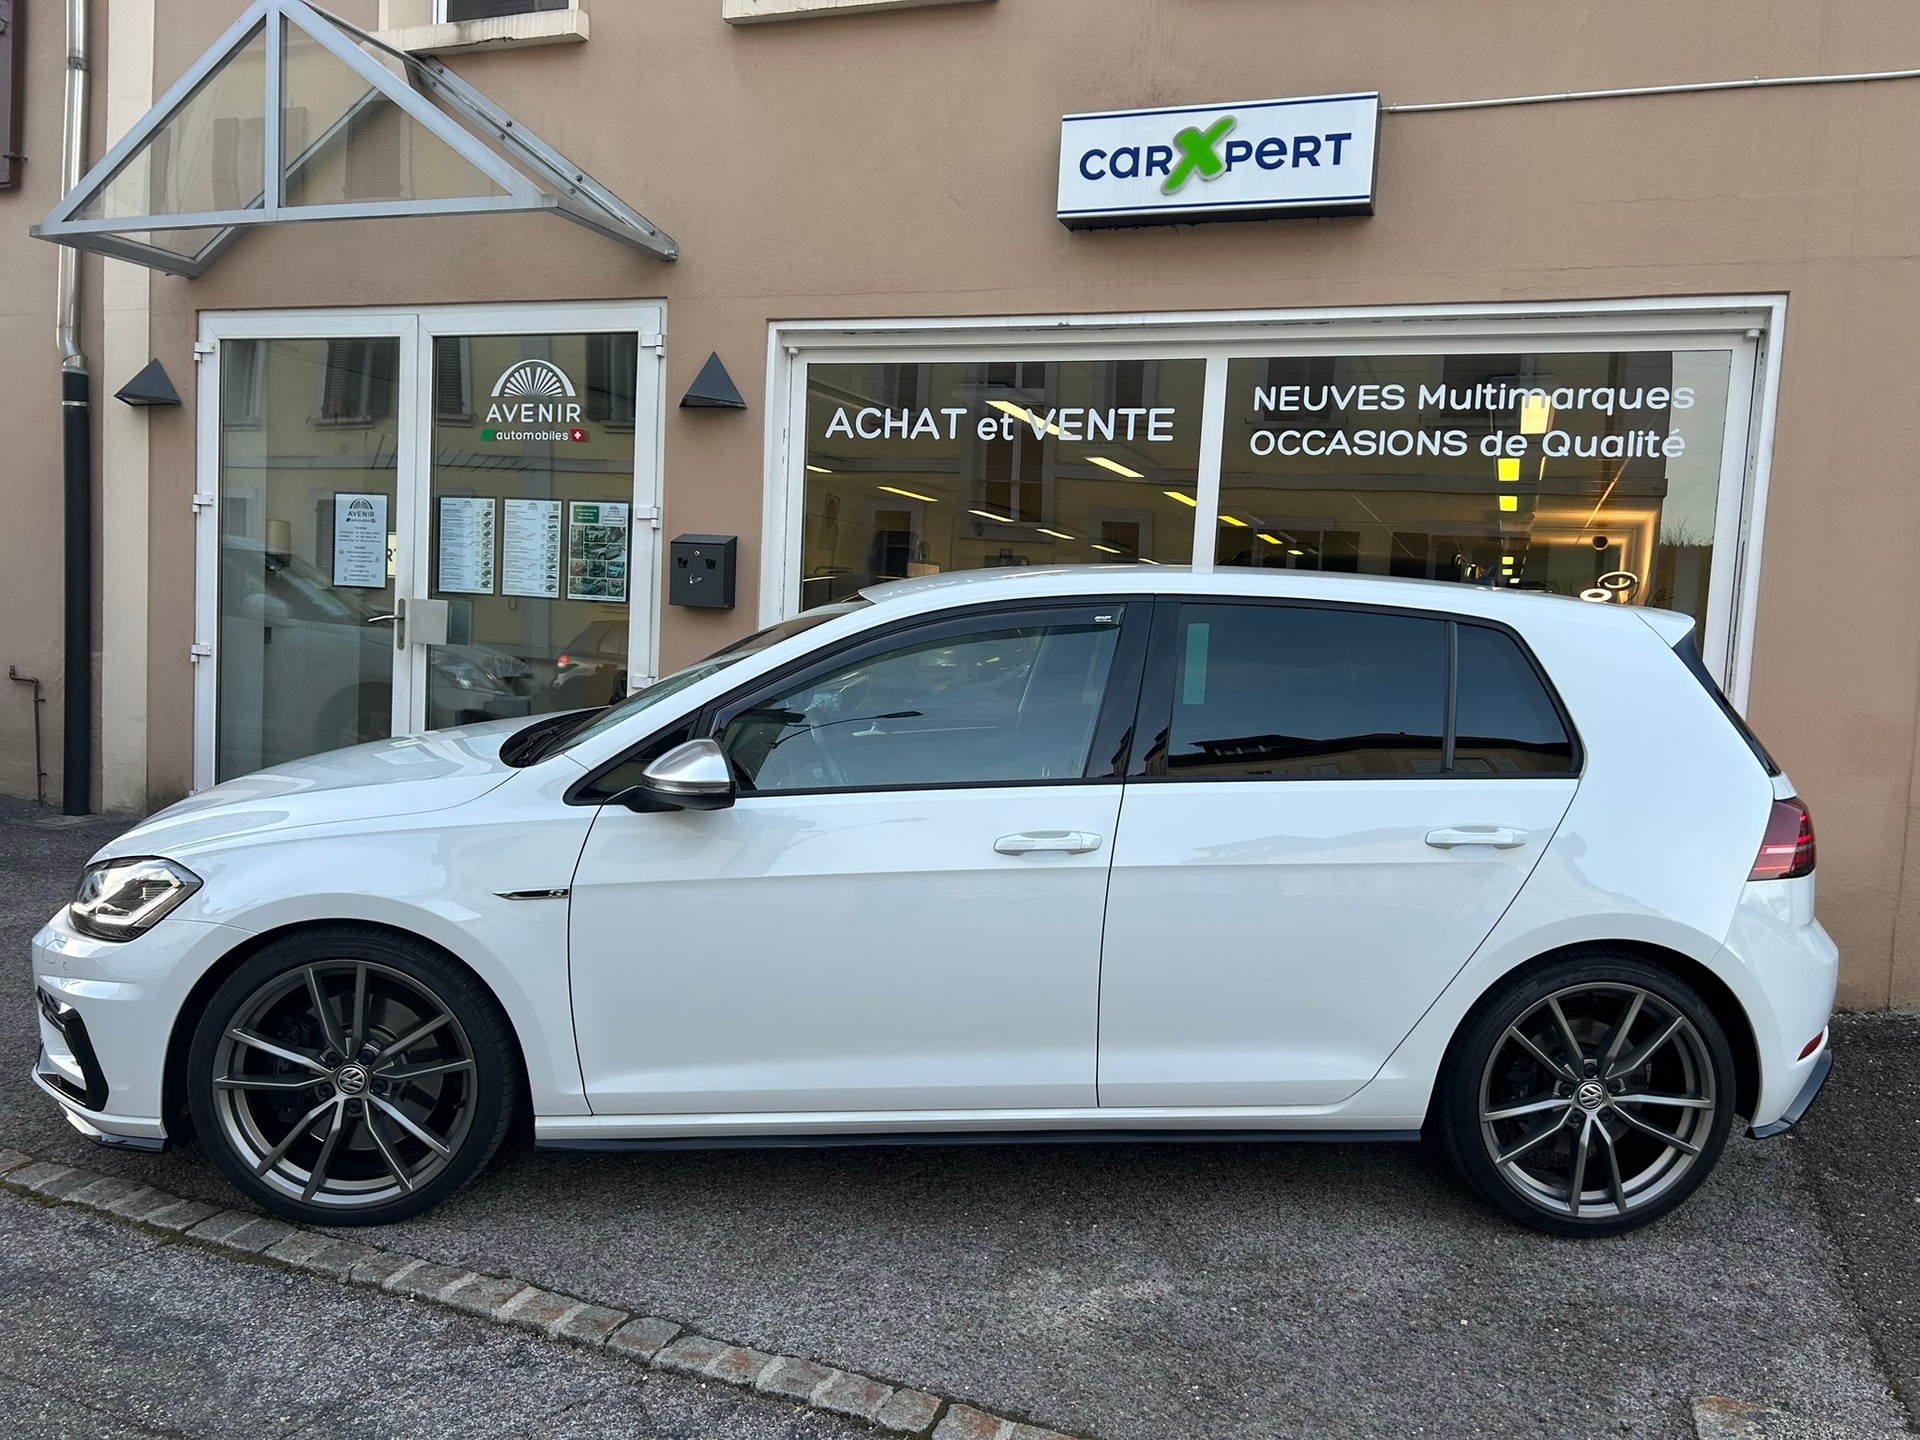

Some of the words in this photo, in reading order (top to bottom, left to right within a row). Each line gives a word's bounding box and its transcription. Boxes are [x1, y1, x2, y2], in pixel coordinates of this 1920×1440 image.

[1252, 384, 1405, 412] NEUVES
[1417, 383, 1696, 416] Multimarques
[485, 403, 581, 423] AVENIR
[825, 407, 967, 440] ACHAT
[976, 415, 1015, 442] et
[1026, 408, 1176, 442] VENTE
[496, 430, 569, 441] automobiles
[1249, 430, 1468, 458] OCCASIONS
[1479, 430, 1528, 458] de
[1541, 428, 1686, 458] Qualité
[347, 510, 375, 518] AVENIR
